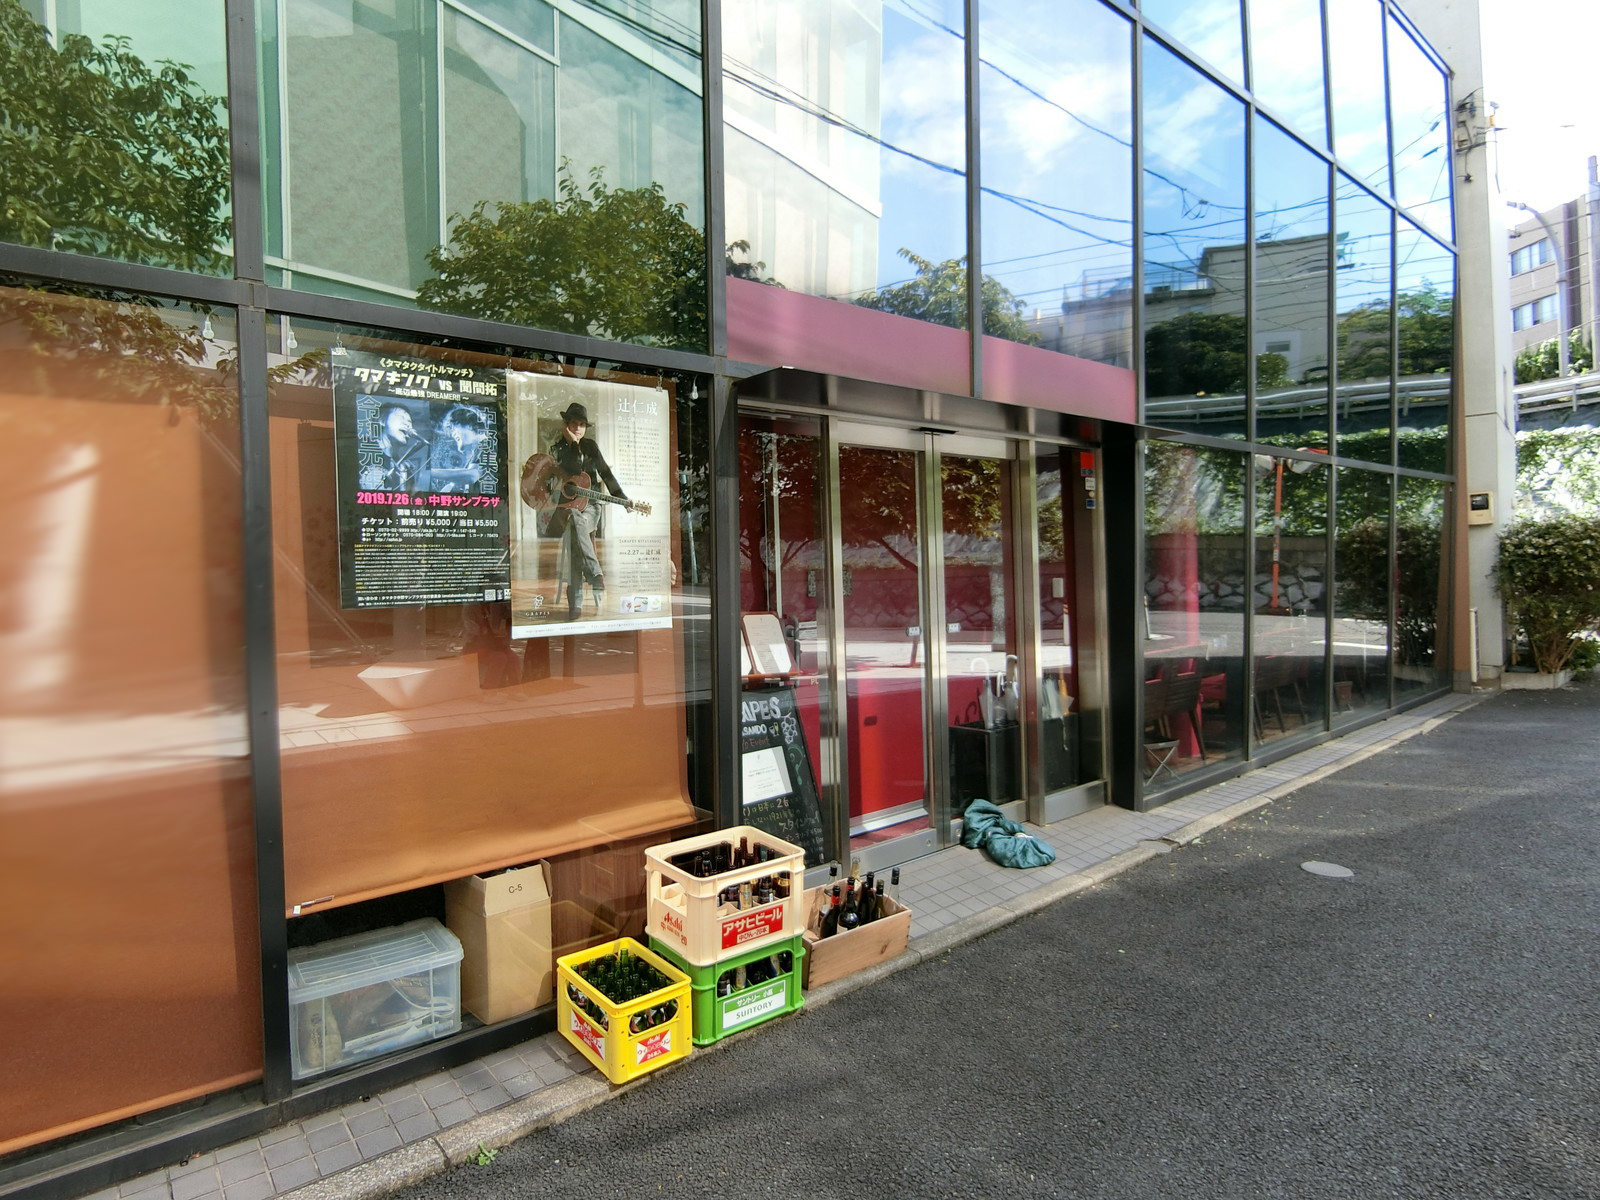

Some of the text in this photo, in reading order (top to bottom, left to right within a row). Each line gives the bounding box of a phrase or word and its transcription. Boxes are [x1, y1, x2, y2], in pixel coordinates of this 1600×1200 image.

[354, 367, 437, 389] タマキング
[439, 379, 453, 392] VS
[618, 398, 659, 416] 辻仁成
[477, 407, 499, 494] 中野集合
[508, 883, 523, 894] C-5
[723, 907, 783, 937] アサヒビール
[736, 993, 761, 1008] サントリー
